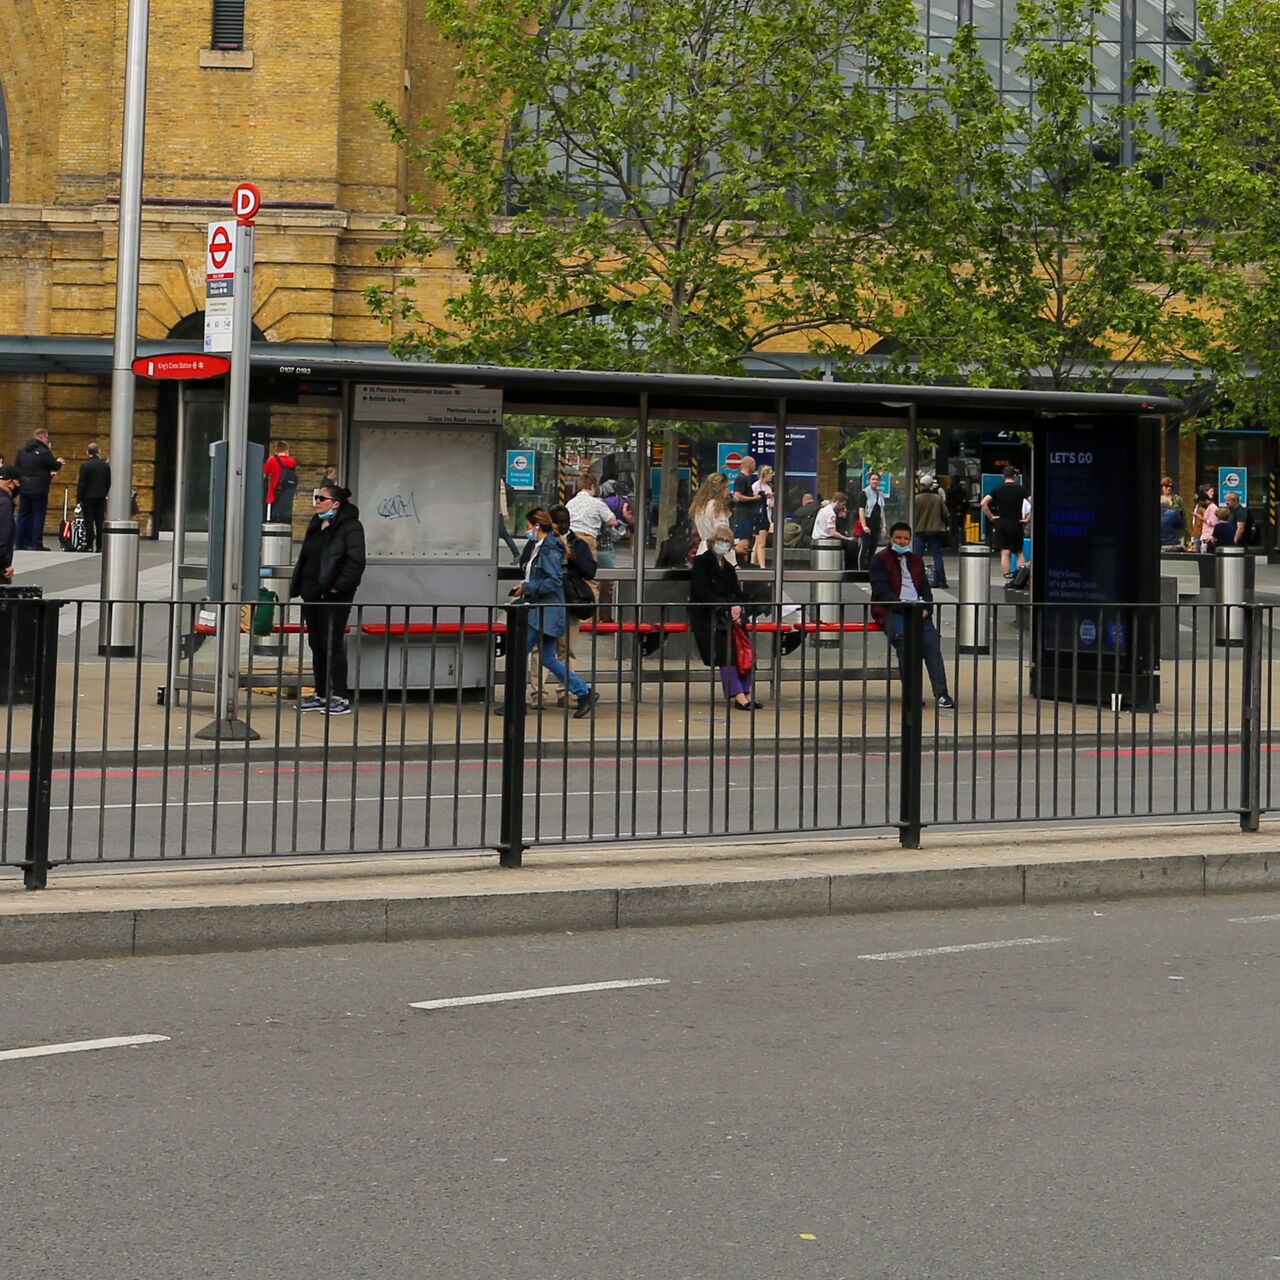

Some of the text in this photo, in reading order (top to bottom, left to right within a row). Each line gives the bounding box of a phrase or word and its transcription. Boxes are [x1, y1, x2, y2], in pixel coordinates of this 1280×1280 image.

[237, 189, 255, 214] D
[1050, 452, 1093, 464] LET'S GO
